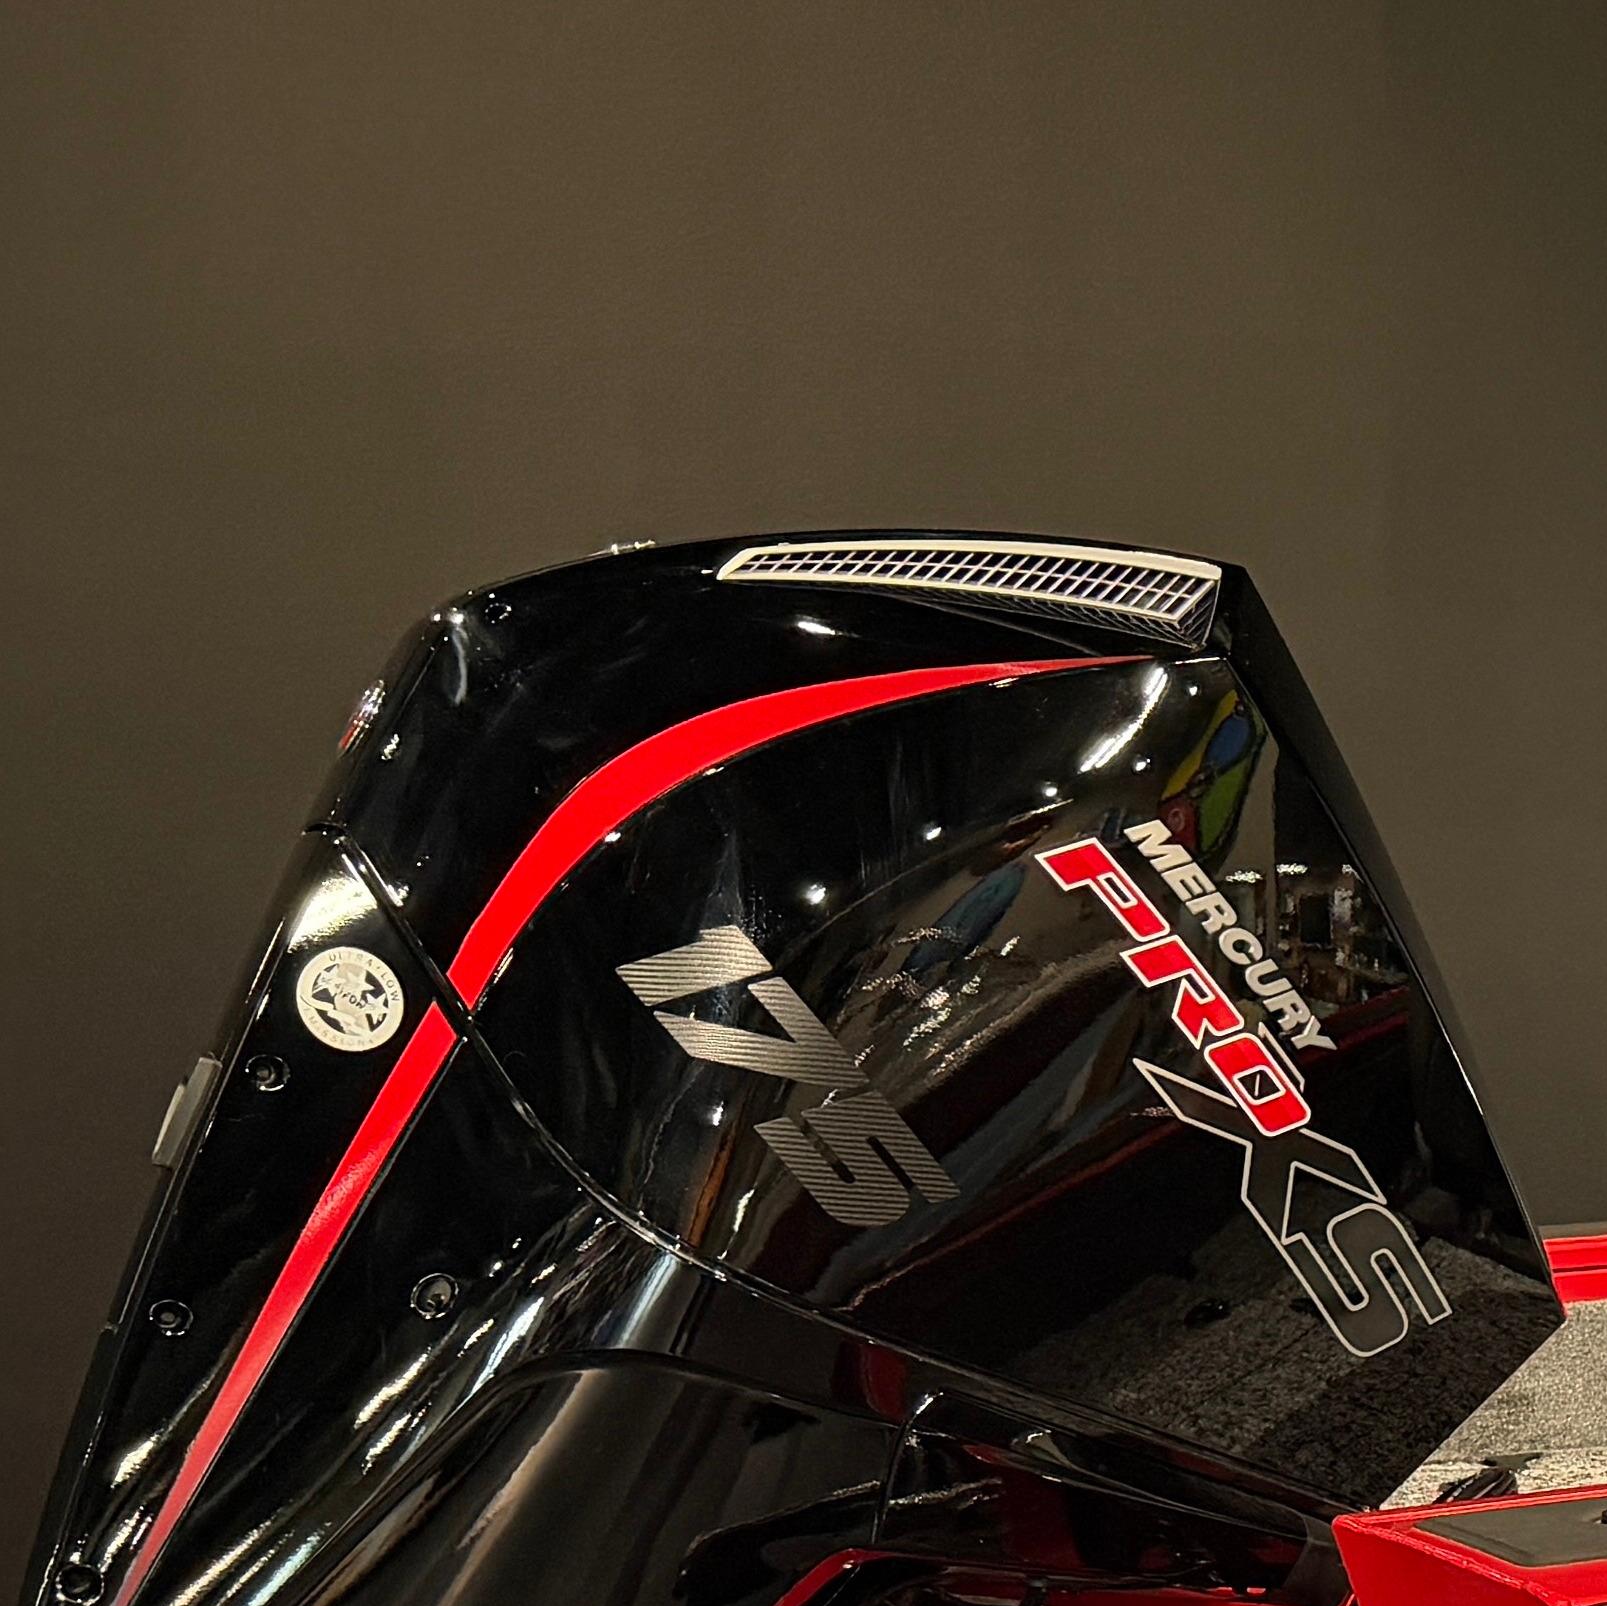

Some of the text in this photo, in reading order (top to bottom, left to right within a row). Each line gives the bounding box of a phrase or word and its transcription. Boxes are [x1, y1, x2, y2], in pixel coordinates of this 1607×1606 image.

[615, 924, 961, 1227] 175
[1034, 837, 1311, 1137] PRO
[1124, 819, 1337, 1053] MERCURY
